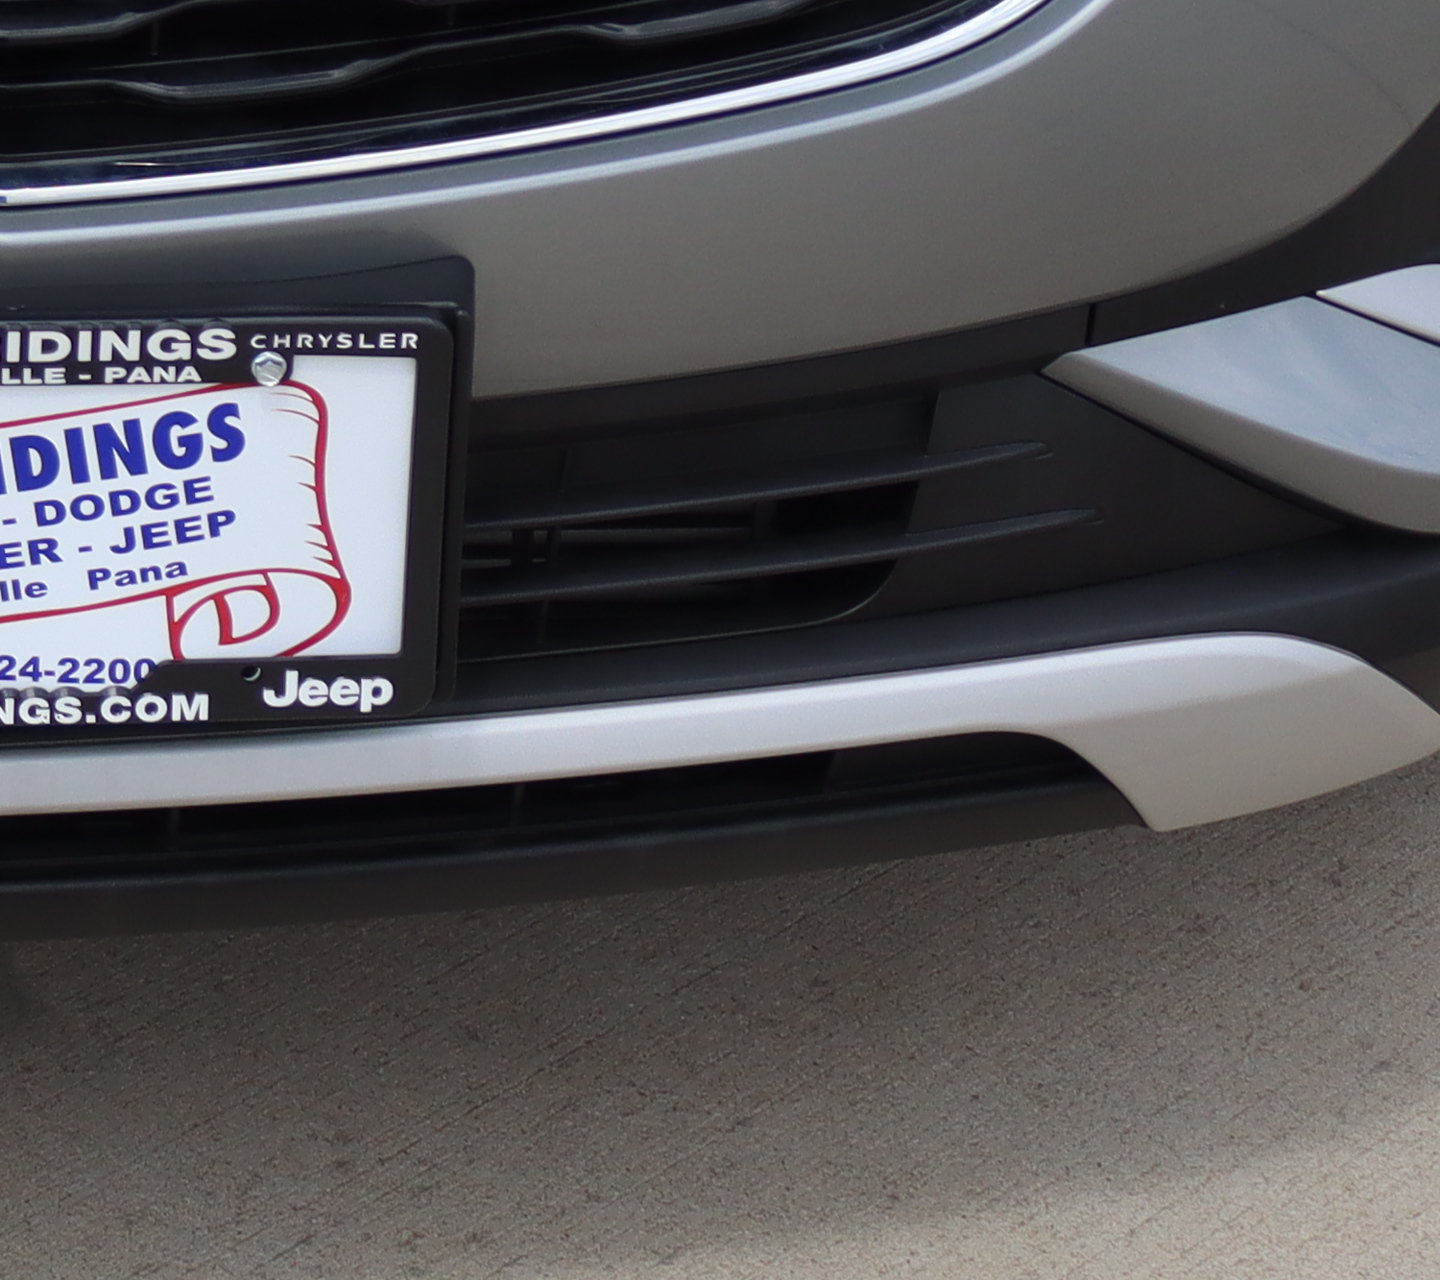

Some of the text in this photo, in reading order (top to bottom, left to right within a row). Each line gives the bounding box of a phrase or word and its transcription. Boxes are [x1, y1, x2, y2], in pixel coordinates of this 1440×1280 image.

[250, 332, 419, 350] CHRYSLER
[104, 366, 202, 384] PANA
[33, 475, 215, 528] DODGE
[109, 509, 237, 555] JEEP
[86, 560, 189, 591] Pana
[262, 669, 395, 714] Jeep
